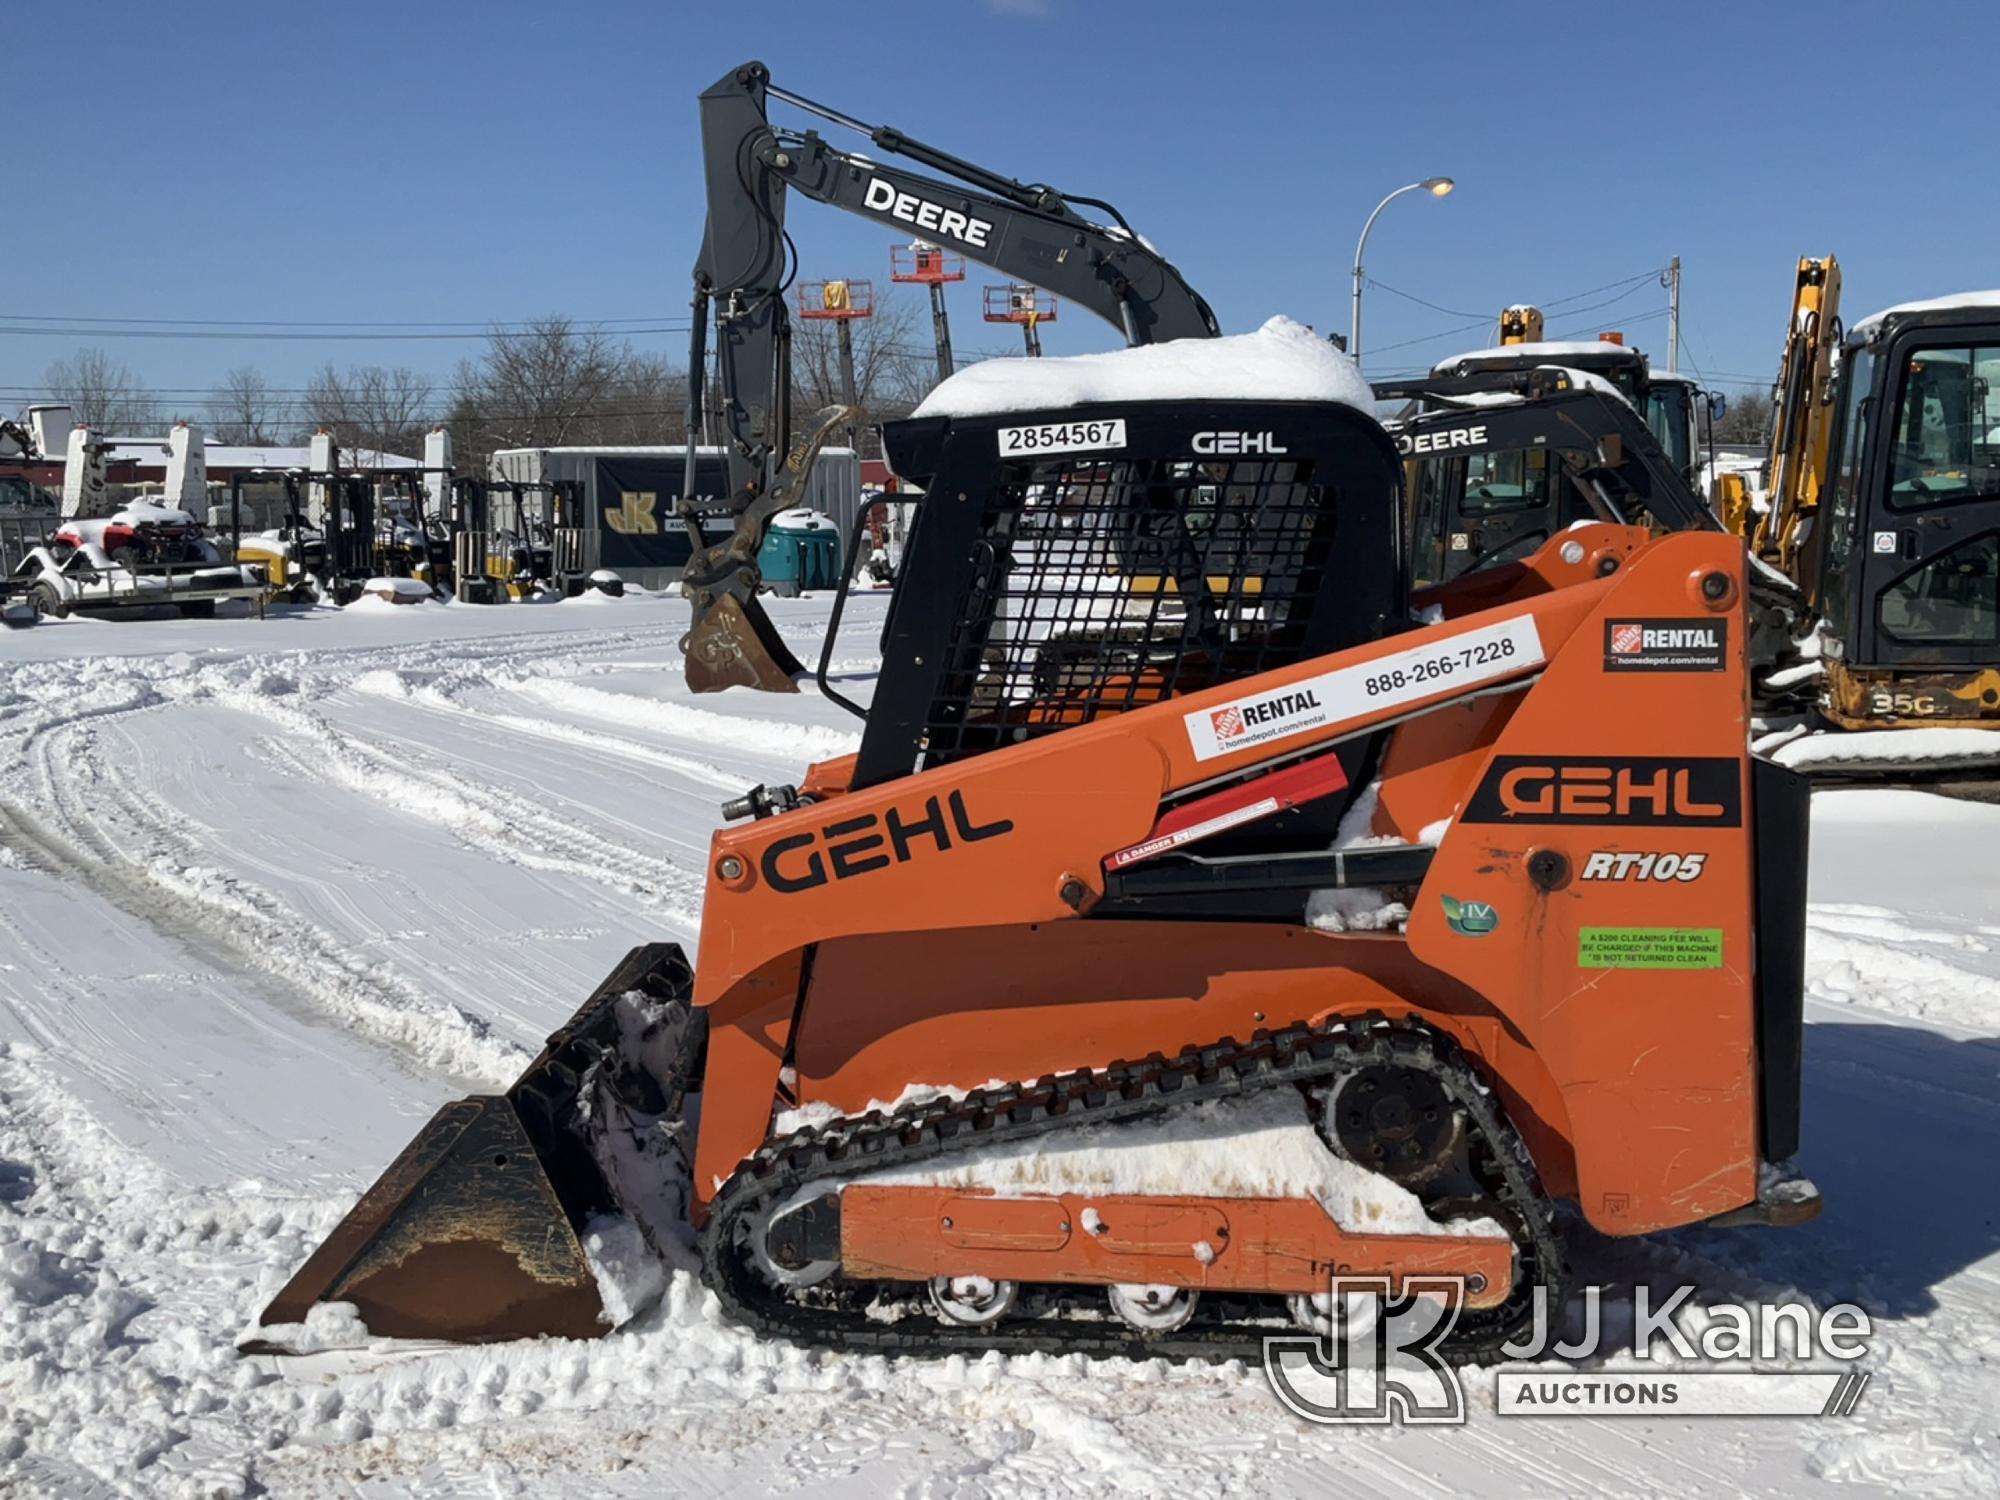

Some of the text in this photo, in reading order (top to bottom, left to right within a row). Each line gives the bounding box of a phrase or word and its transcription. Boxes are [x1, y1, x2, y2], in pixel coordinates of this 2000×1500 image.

[864, 177, 992, 248] DEERE
[1007, 421, 1117, 450] 2854567
[1191, 431, 1288, 454] GEHL
[605, 491, 658, 534] JK
[1642, 629, 1719, 648] RENTAL
[1365, 638, 1515, 696] 888-266-7228
[1617, 656, 1719, 666] homedepot.com/rental
[1242, 689, 1321, 727] RENTAL
[1872, 693, 1935, 714] 35G
[1225, 713, 1326, 750] homedepot.com/rental
[1499, 766, 1725, 817] GEHL
[760, 789, 1014, 894] GEHL
[1131, 838, 1172, 857] DANGER
[1580, 852, 1708, 882] RT105
[1582, 944, 1594, 952] BE
[1596, 944, 1642, 952] CHARGED
[1655, 944, 1675, 952] THIS
[1676, 944, 1718, 952] MACHINE
[1590, 934, 1597, 942] A
[1620, 934, 1667, 942] CLEANING
[1669, 934, 1686, 942] FEE
[1688, 934, 1710, 942] WILL
[1604, 954, 1622, 962] NOT
[1625, 954, 1675, 962] RETURNED
[1676, 954, 1707, 962] CLEAN
